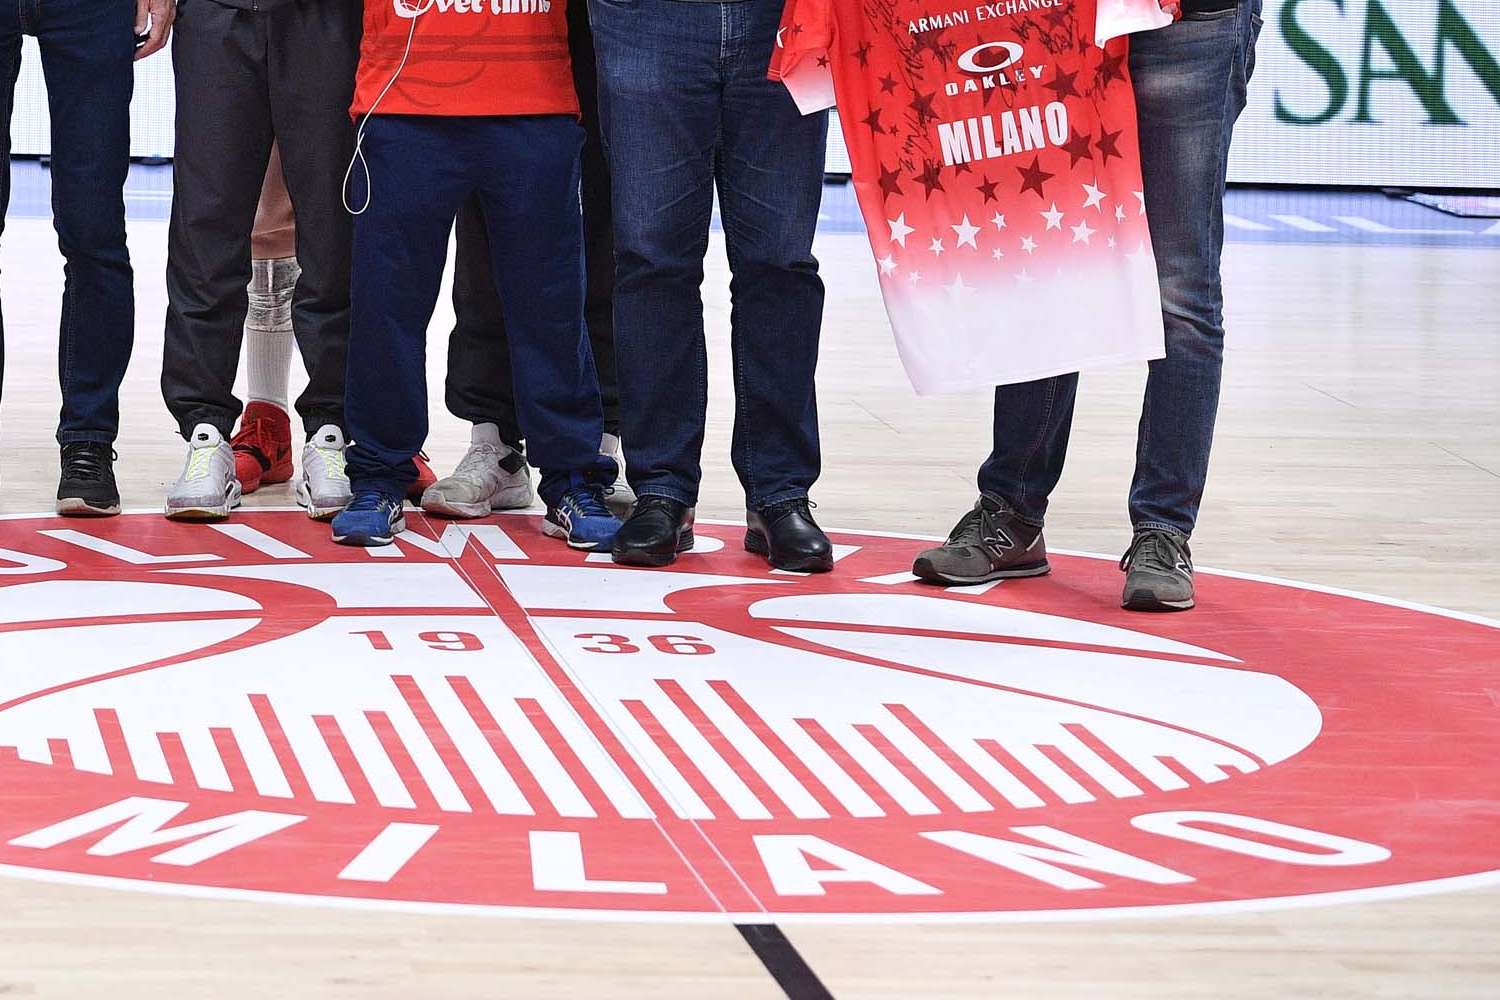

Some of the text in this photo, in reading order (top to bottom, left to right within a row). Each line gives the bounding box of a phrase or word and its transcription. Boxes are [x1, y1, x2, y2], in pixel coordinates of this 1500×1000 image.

[907, 8, 970, 36] ARMANI
[944, 65, 1045, 97] OAKLEY
[937, 101, 1069, 167] MILANO
[7, 796, 1392, 897] MILANO
